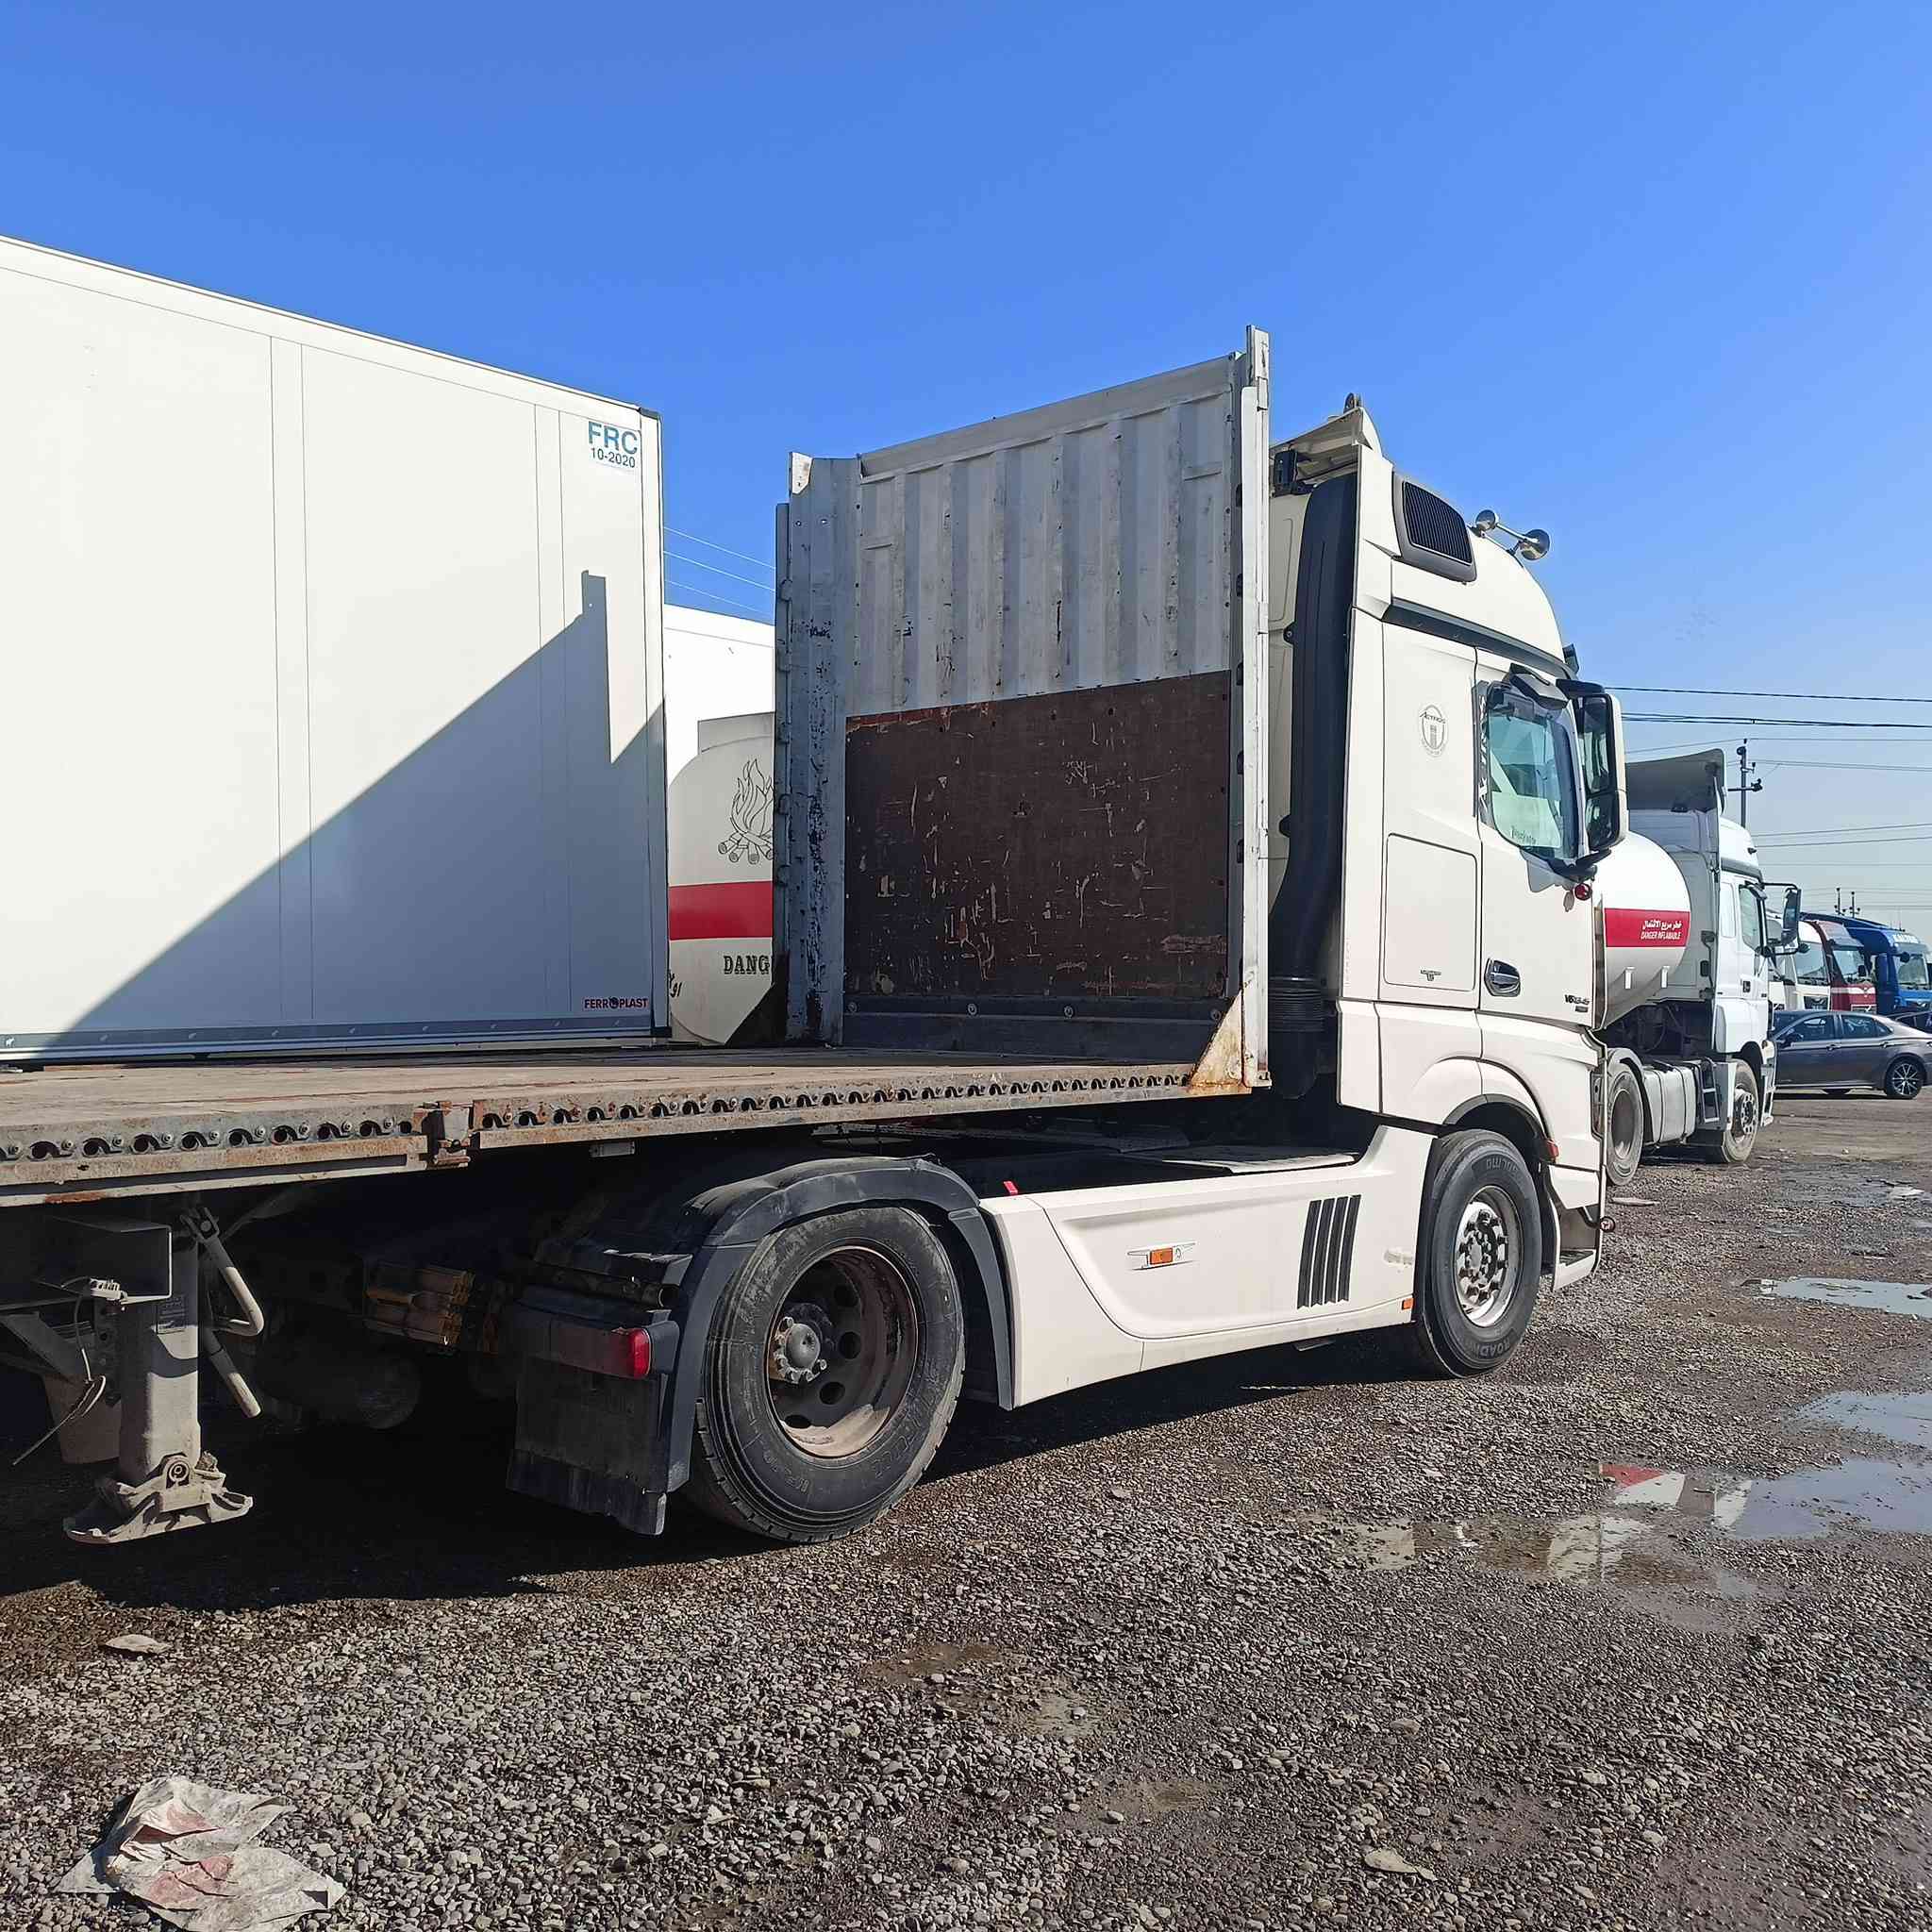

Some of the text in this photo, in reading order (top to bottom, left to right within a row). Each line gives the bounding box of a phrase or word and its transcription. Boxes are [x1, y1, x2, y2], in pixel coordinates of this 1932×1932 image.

[589, 421, 638, 455] FRC
[591, 447, 636, 468] 10-2020
[584, 997, 648, 1009] FERROPLAST
